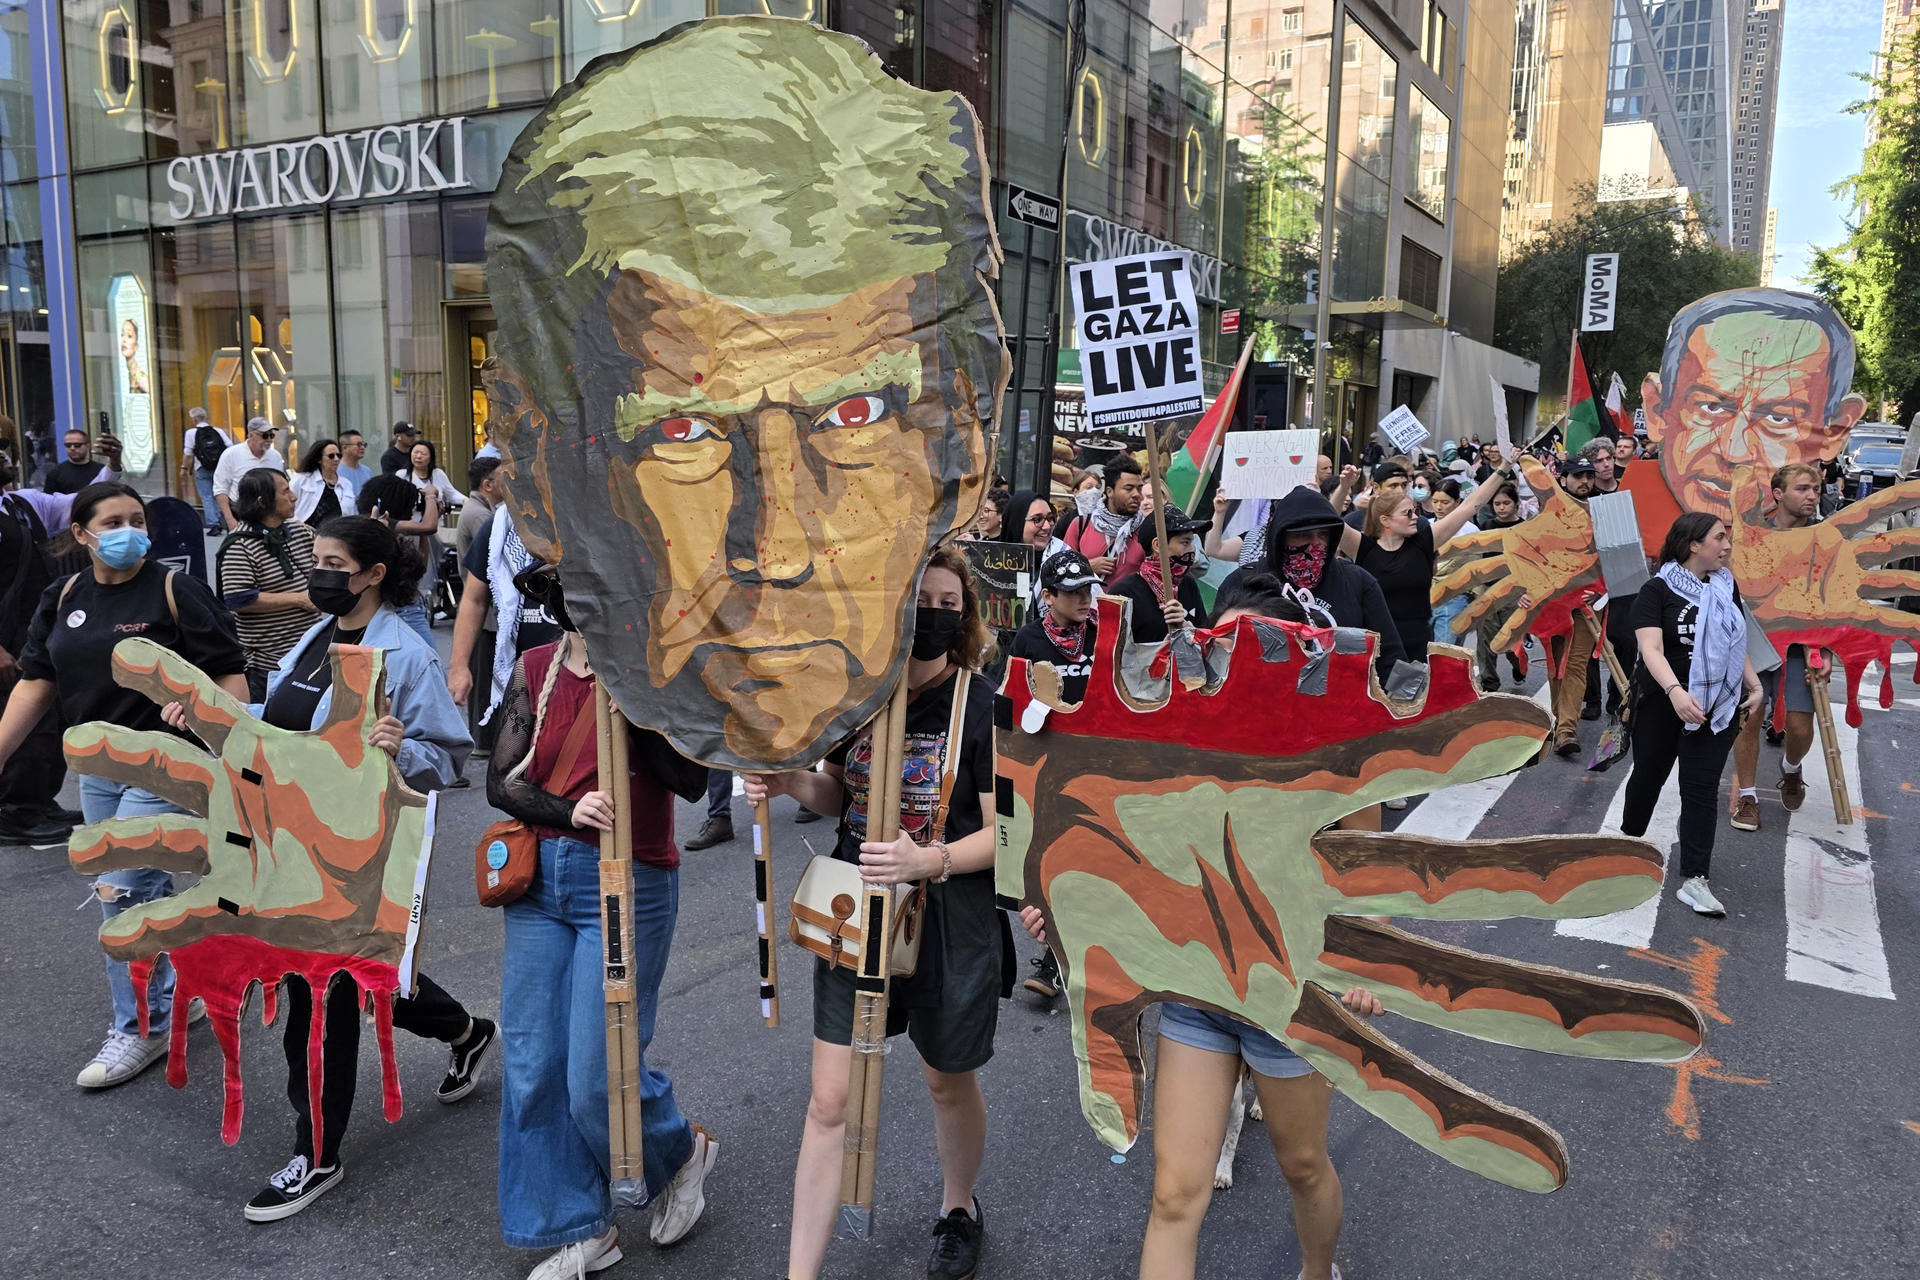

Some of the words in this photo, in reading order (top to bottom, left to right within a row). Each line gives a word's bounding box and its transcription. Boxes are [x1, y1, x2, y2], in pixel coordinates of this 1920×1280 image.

[167, 117, 472, 220] SWAROVSKI
[1018, 198, 1032, 214] ONE
[1039, 205, 1055, 220] WAY
[1085, 215, 1226, 303] SWSKI
[1080, 258, 1183, 313] LET
[1588, 257, 1613, 327] MoMA
[1367, 296, 1399, 312] 680
[1084, 302, 1192, 343] GAZA
[1089, 337, 1197, 397] LIVE
[1054, 400, 1078, 414] THE
[1094, 400, 1201, 425] #SHUTITDOWN4PALESTINE
[1227, 432, 1274, 454] NEVER
[1276, 429, 1318, 453] AGAIN
[1394, 422, 1418, 441] FREE
[1255, 456, 1280, 465] FOR
[1314, 597, 1332, 611] THE
[113, 622, 149, 632] PCRF
[523, 615, 542, 624] STATE
